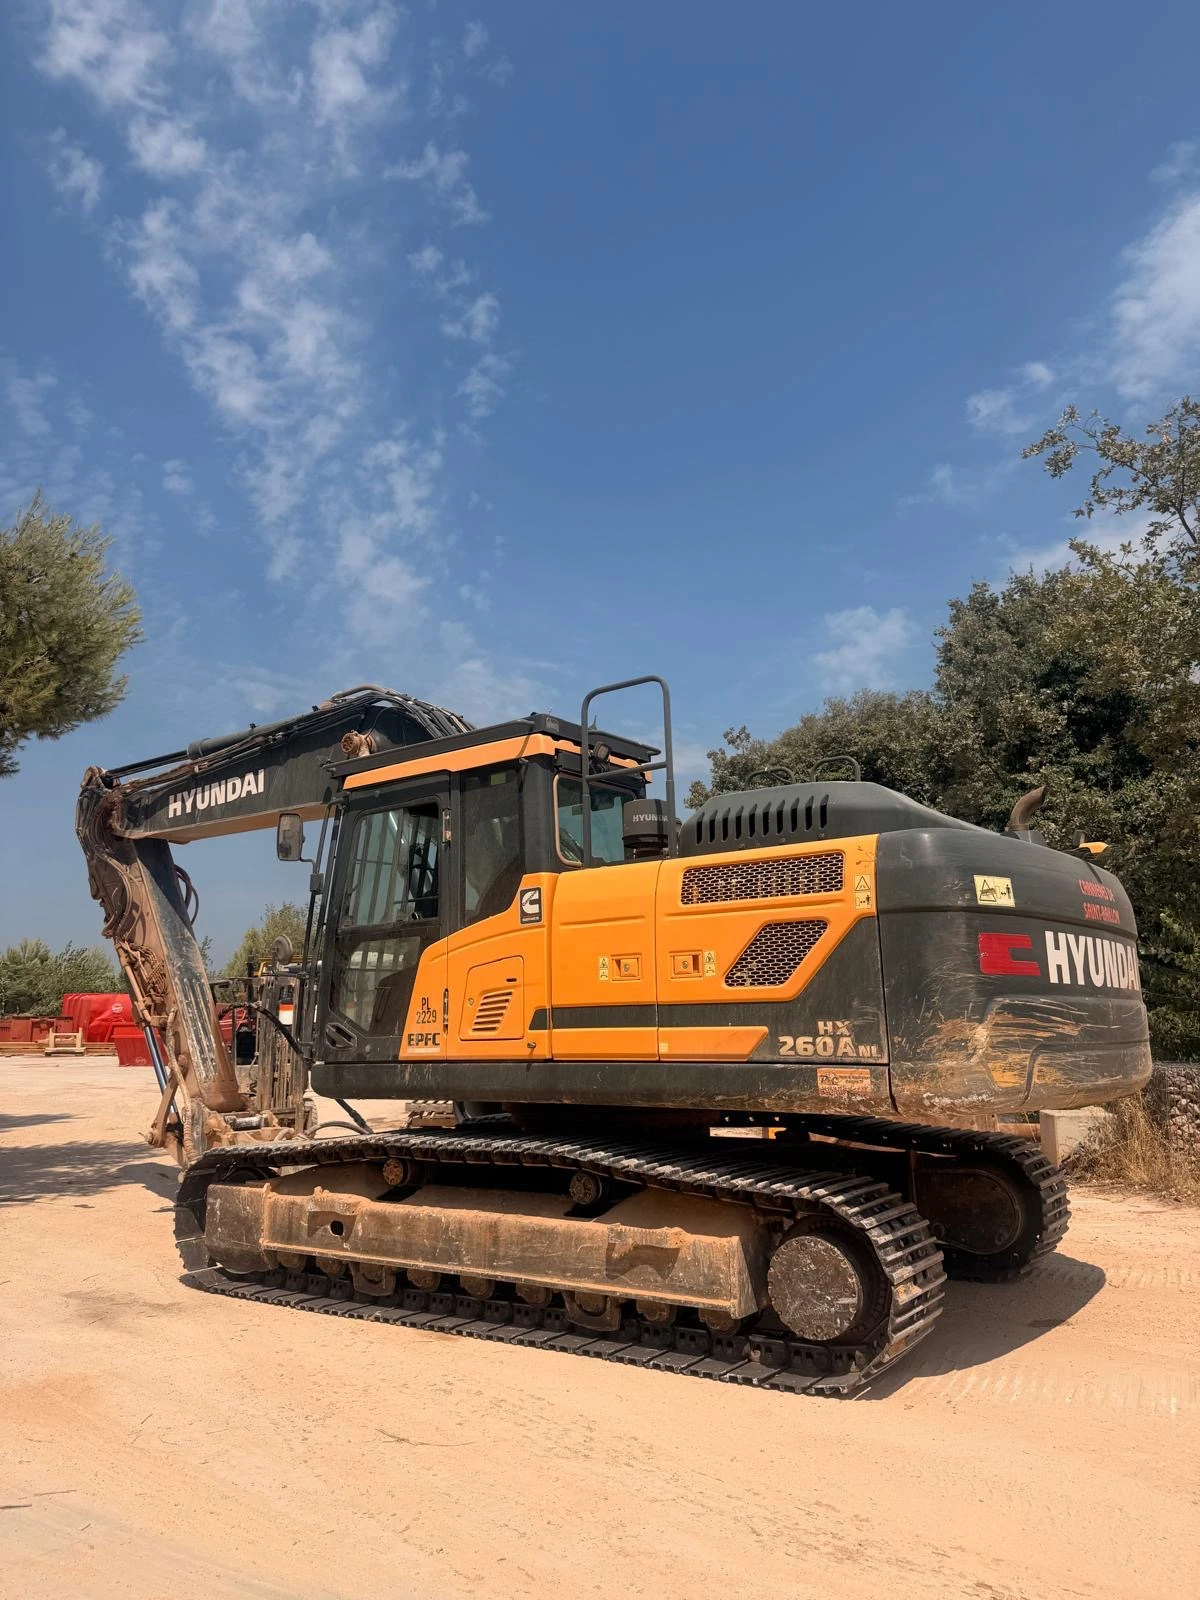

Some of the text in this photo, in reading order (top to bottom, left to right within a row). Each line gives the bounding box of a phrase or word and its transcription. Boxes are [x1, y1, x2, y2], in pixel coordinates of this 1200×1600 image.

[168, 769, 265, 818] HYUNDAI
[632, 814, 669, 822] HYUNDA
[421, 997, 431, 1010] PL
[416, 1010, 437, 1025] 2229
[817, 1020, 851, 1036] HX
[407, 1032, 441, 1047] EPFC
